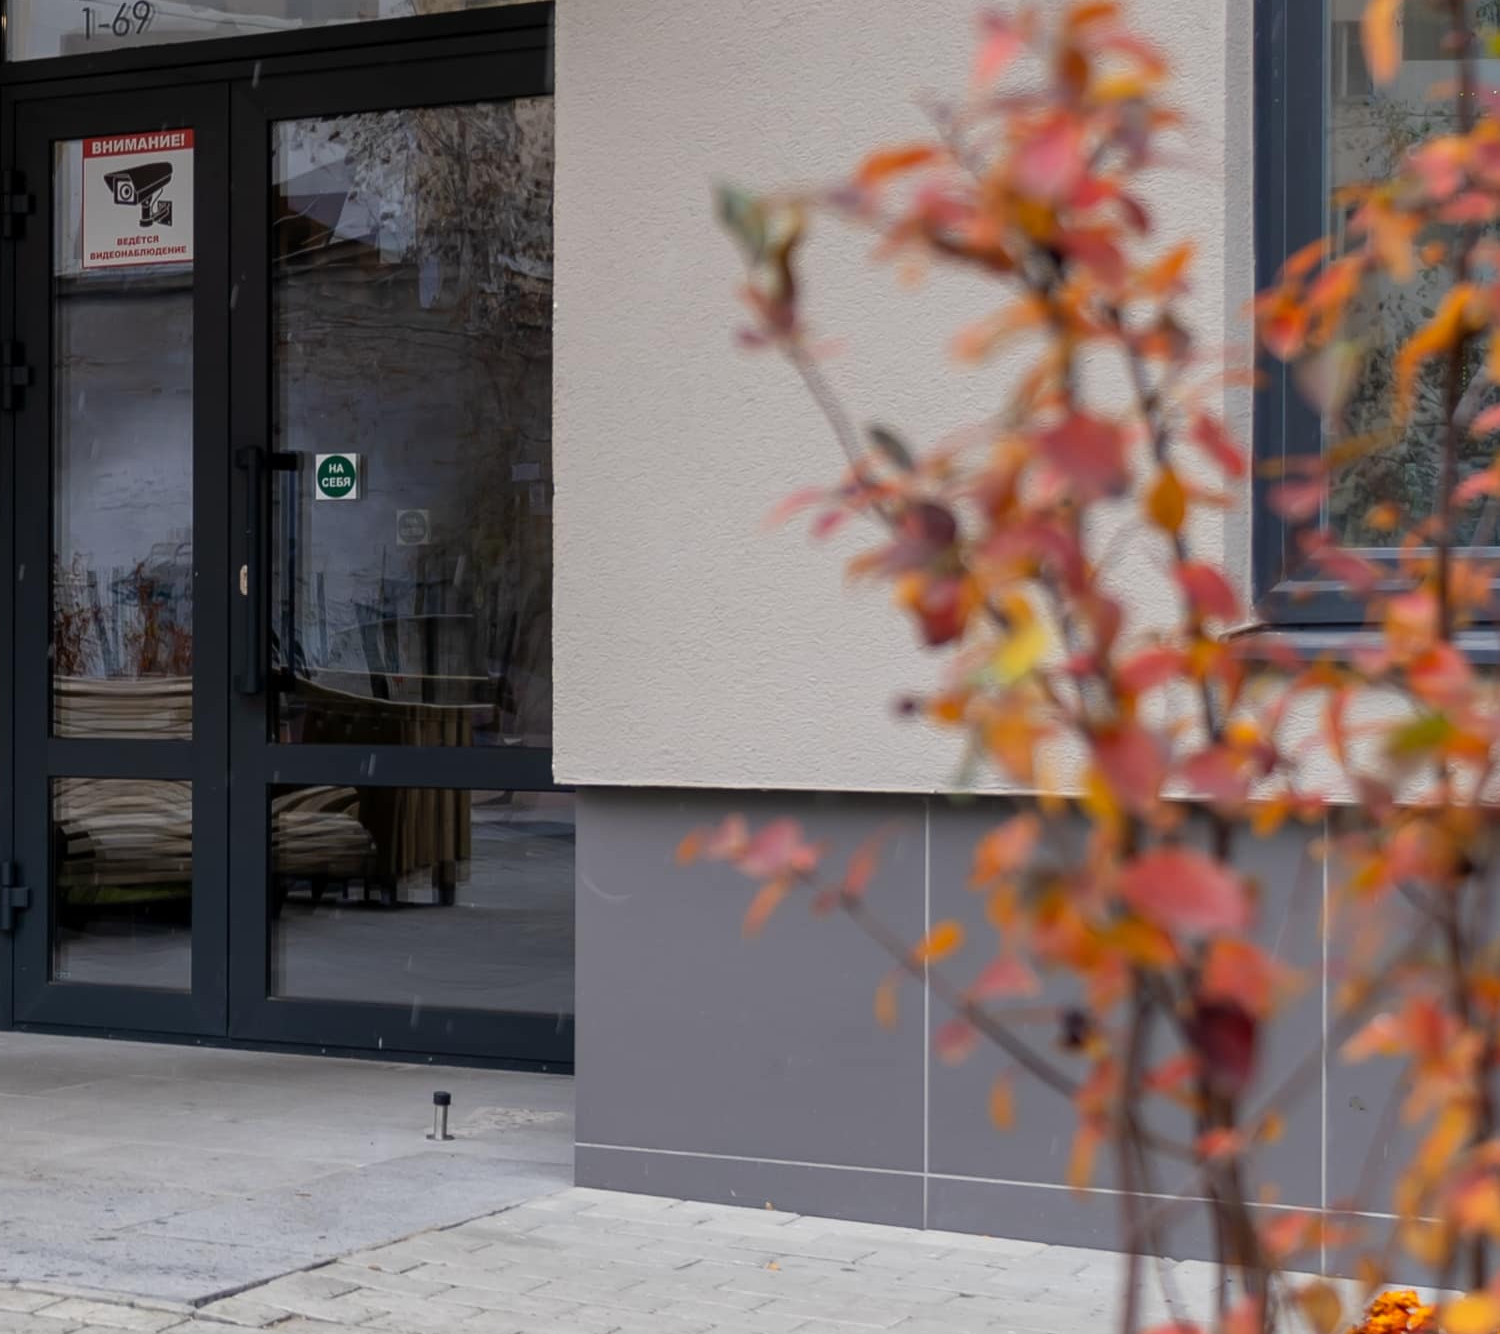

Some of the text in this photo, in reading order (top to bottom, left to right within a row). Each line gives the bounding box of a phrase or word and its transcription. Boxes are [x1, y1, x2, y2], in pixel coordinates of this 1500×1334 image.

[82, 0, 151, 40] 1-69
[91, 132, 185, 155] ВНИМАНИЕ!
[116, 234, 160, 247] ВЕДЁТСЯ
[89, 245, 187, 261] ВИДЕОНАБЛЮДЕНИЕ
[328, 463, 344, 474] НА
[321, 476, 351, 488] СЕБЯ
